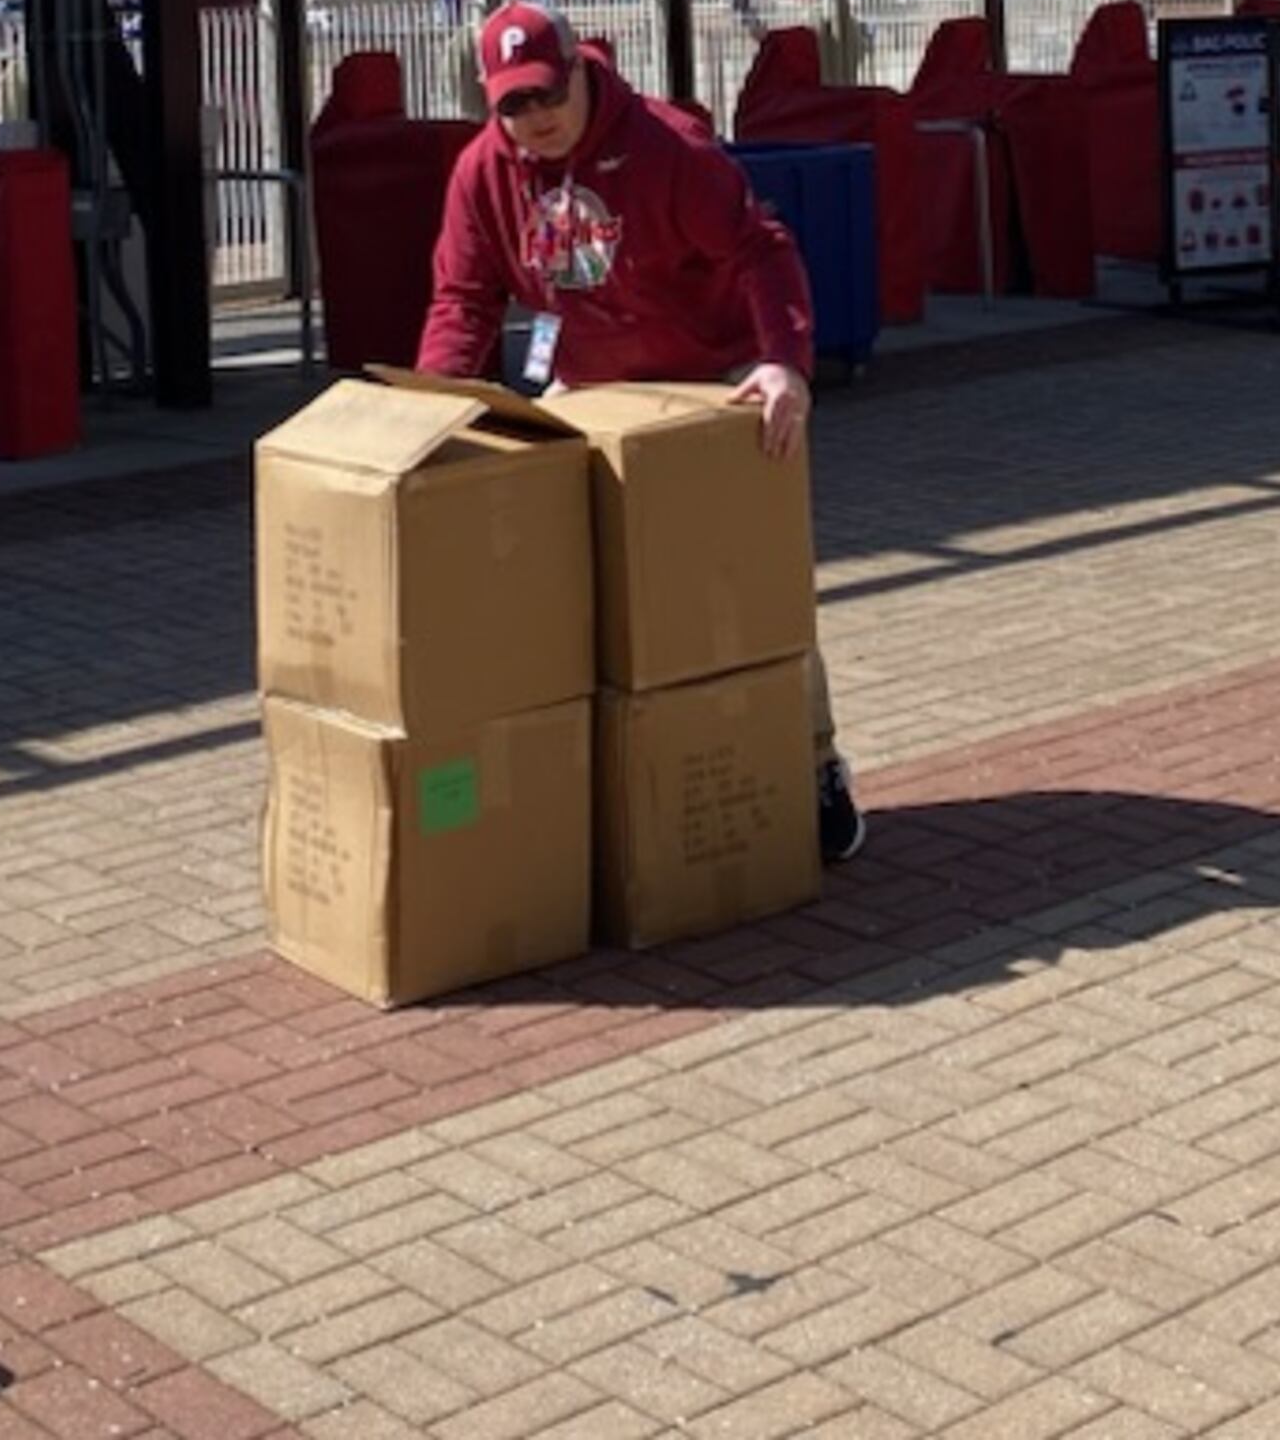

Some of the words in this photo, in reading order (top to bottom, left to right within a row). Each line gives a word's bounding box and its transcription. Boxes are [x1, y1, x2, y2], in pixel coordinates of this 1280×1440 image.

[500, 26, 526, 63] P
[1193, 36, 1221, 51] BAG
[1223, 33, 1268, 49] POLIC
